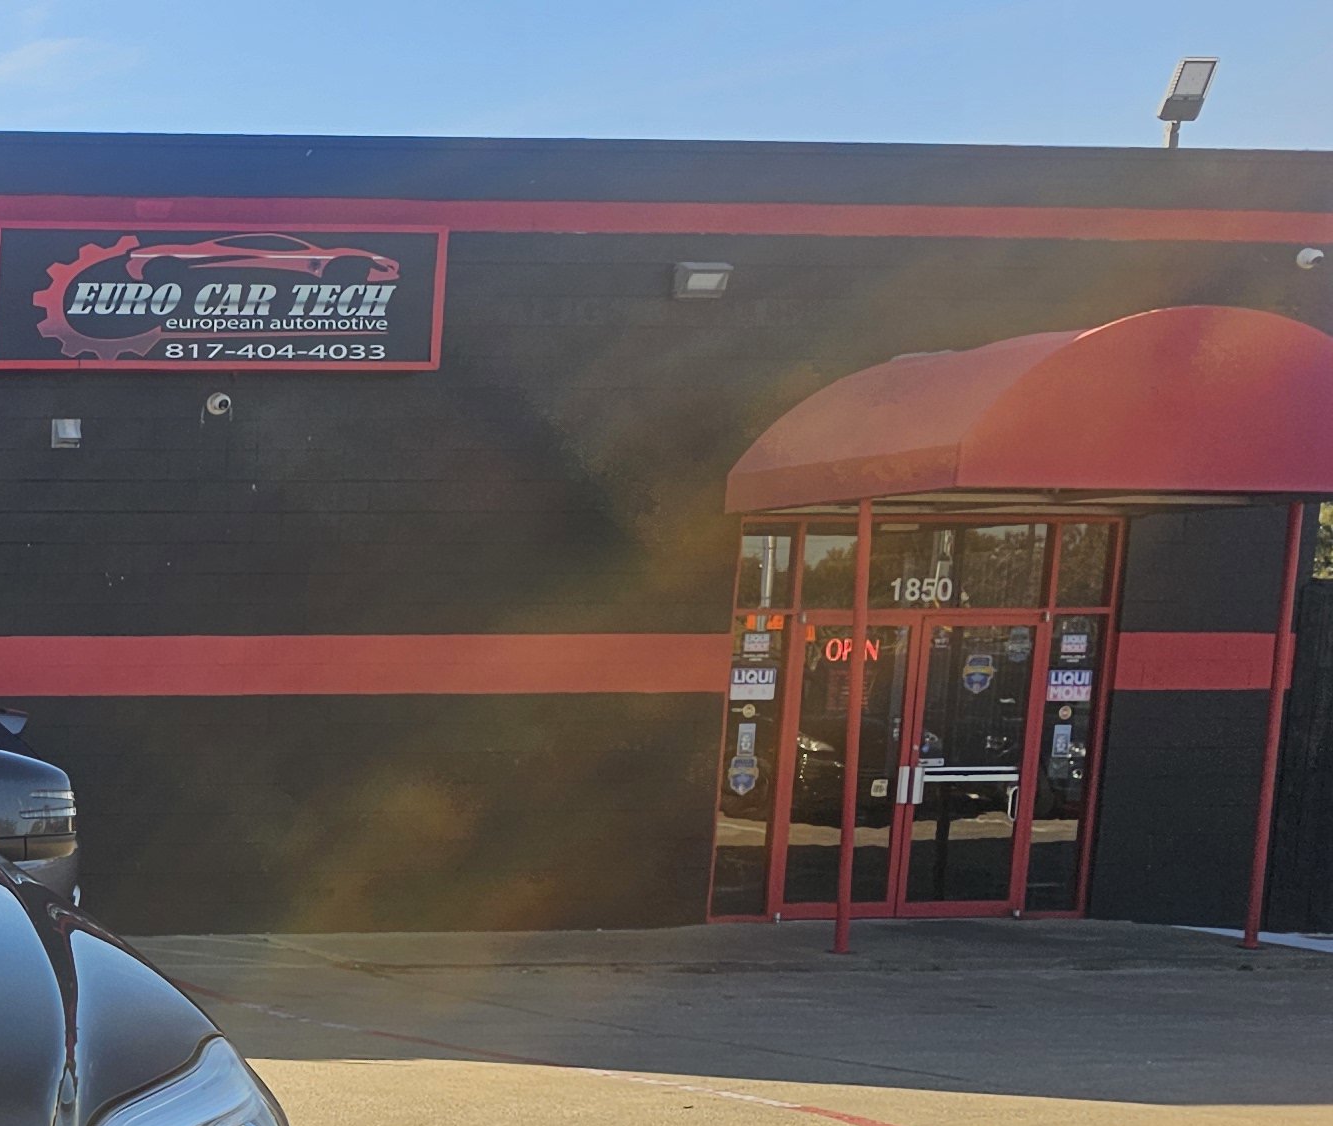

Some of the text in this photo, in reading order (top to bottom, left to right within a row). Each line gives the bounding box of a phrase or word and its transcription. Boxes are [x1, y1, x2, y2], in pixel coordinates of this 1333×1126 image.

[66, 282, 397, 318] EURO CAR TECH
[165, 317, 389, 334] european automotive
[164, 342, 387, 360] 817-404-4033
[890, 577, 953, 602] 1850
[825, 637, 880, 662] OPN
[733, 668, 775, 684] LIQUI
[1050, 671, 1091, 685] LIQUI
